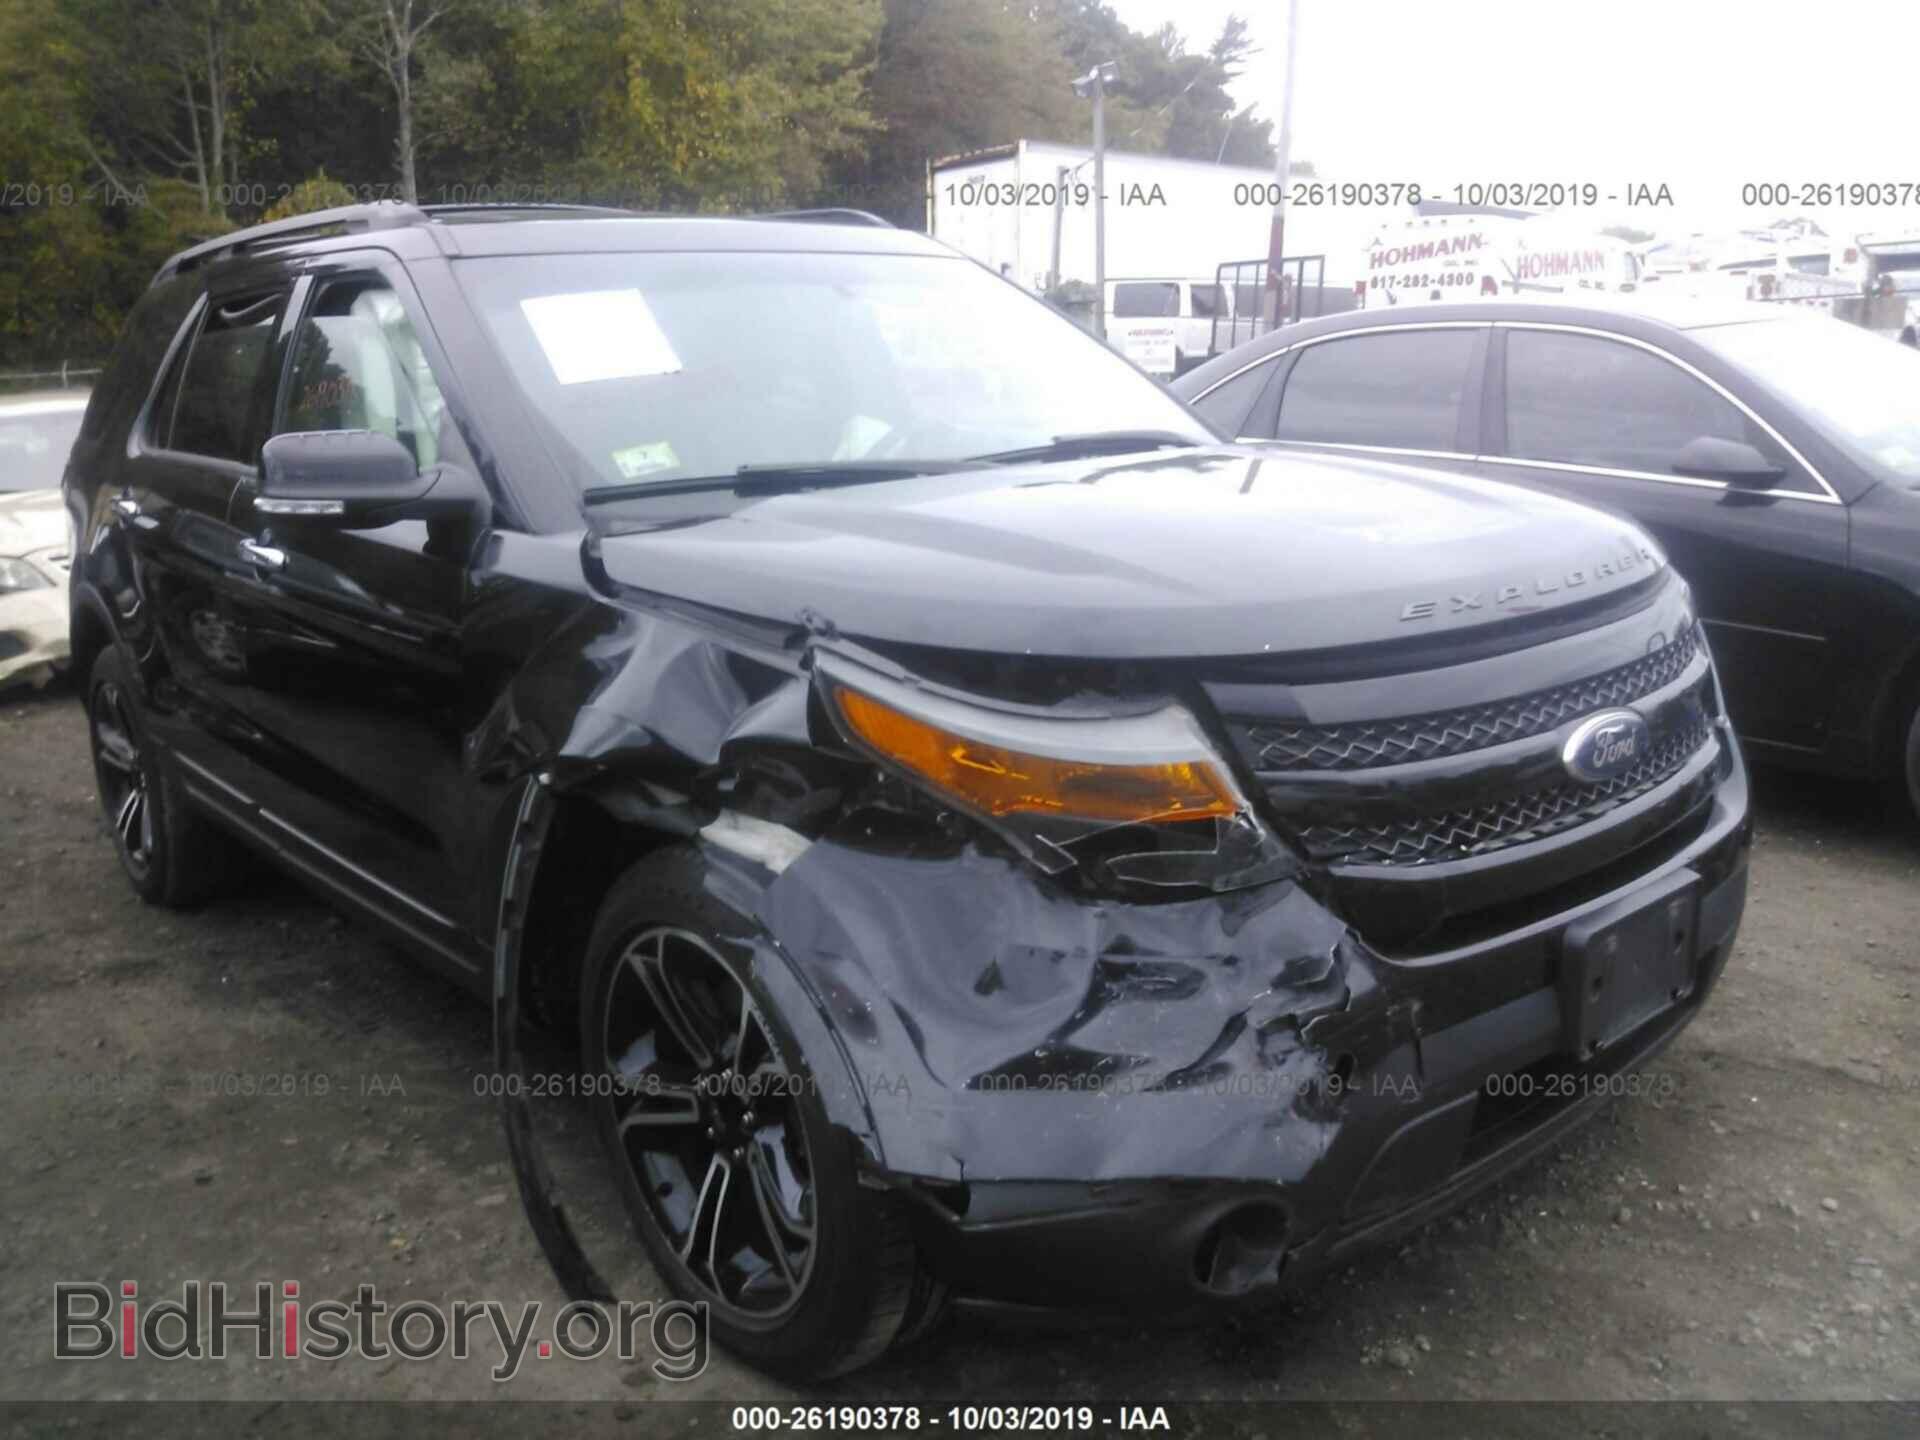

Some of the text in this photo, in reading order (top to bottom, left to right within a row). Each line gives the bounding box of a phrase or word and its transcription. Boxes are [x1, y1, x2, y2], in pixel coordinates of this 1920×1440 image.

[1369, 232, 1483, 270] HOHMANN
[1517, 250, 1604, 279] HOHMANN
[1592, 722, 1637, 768] Ford
